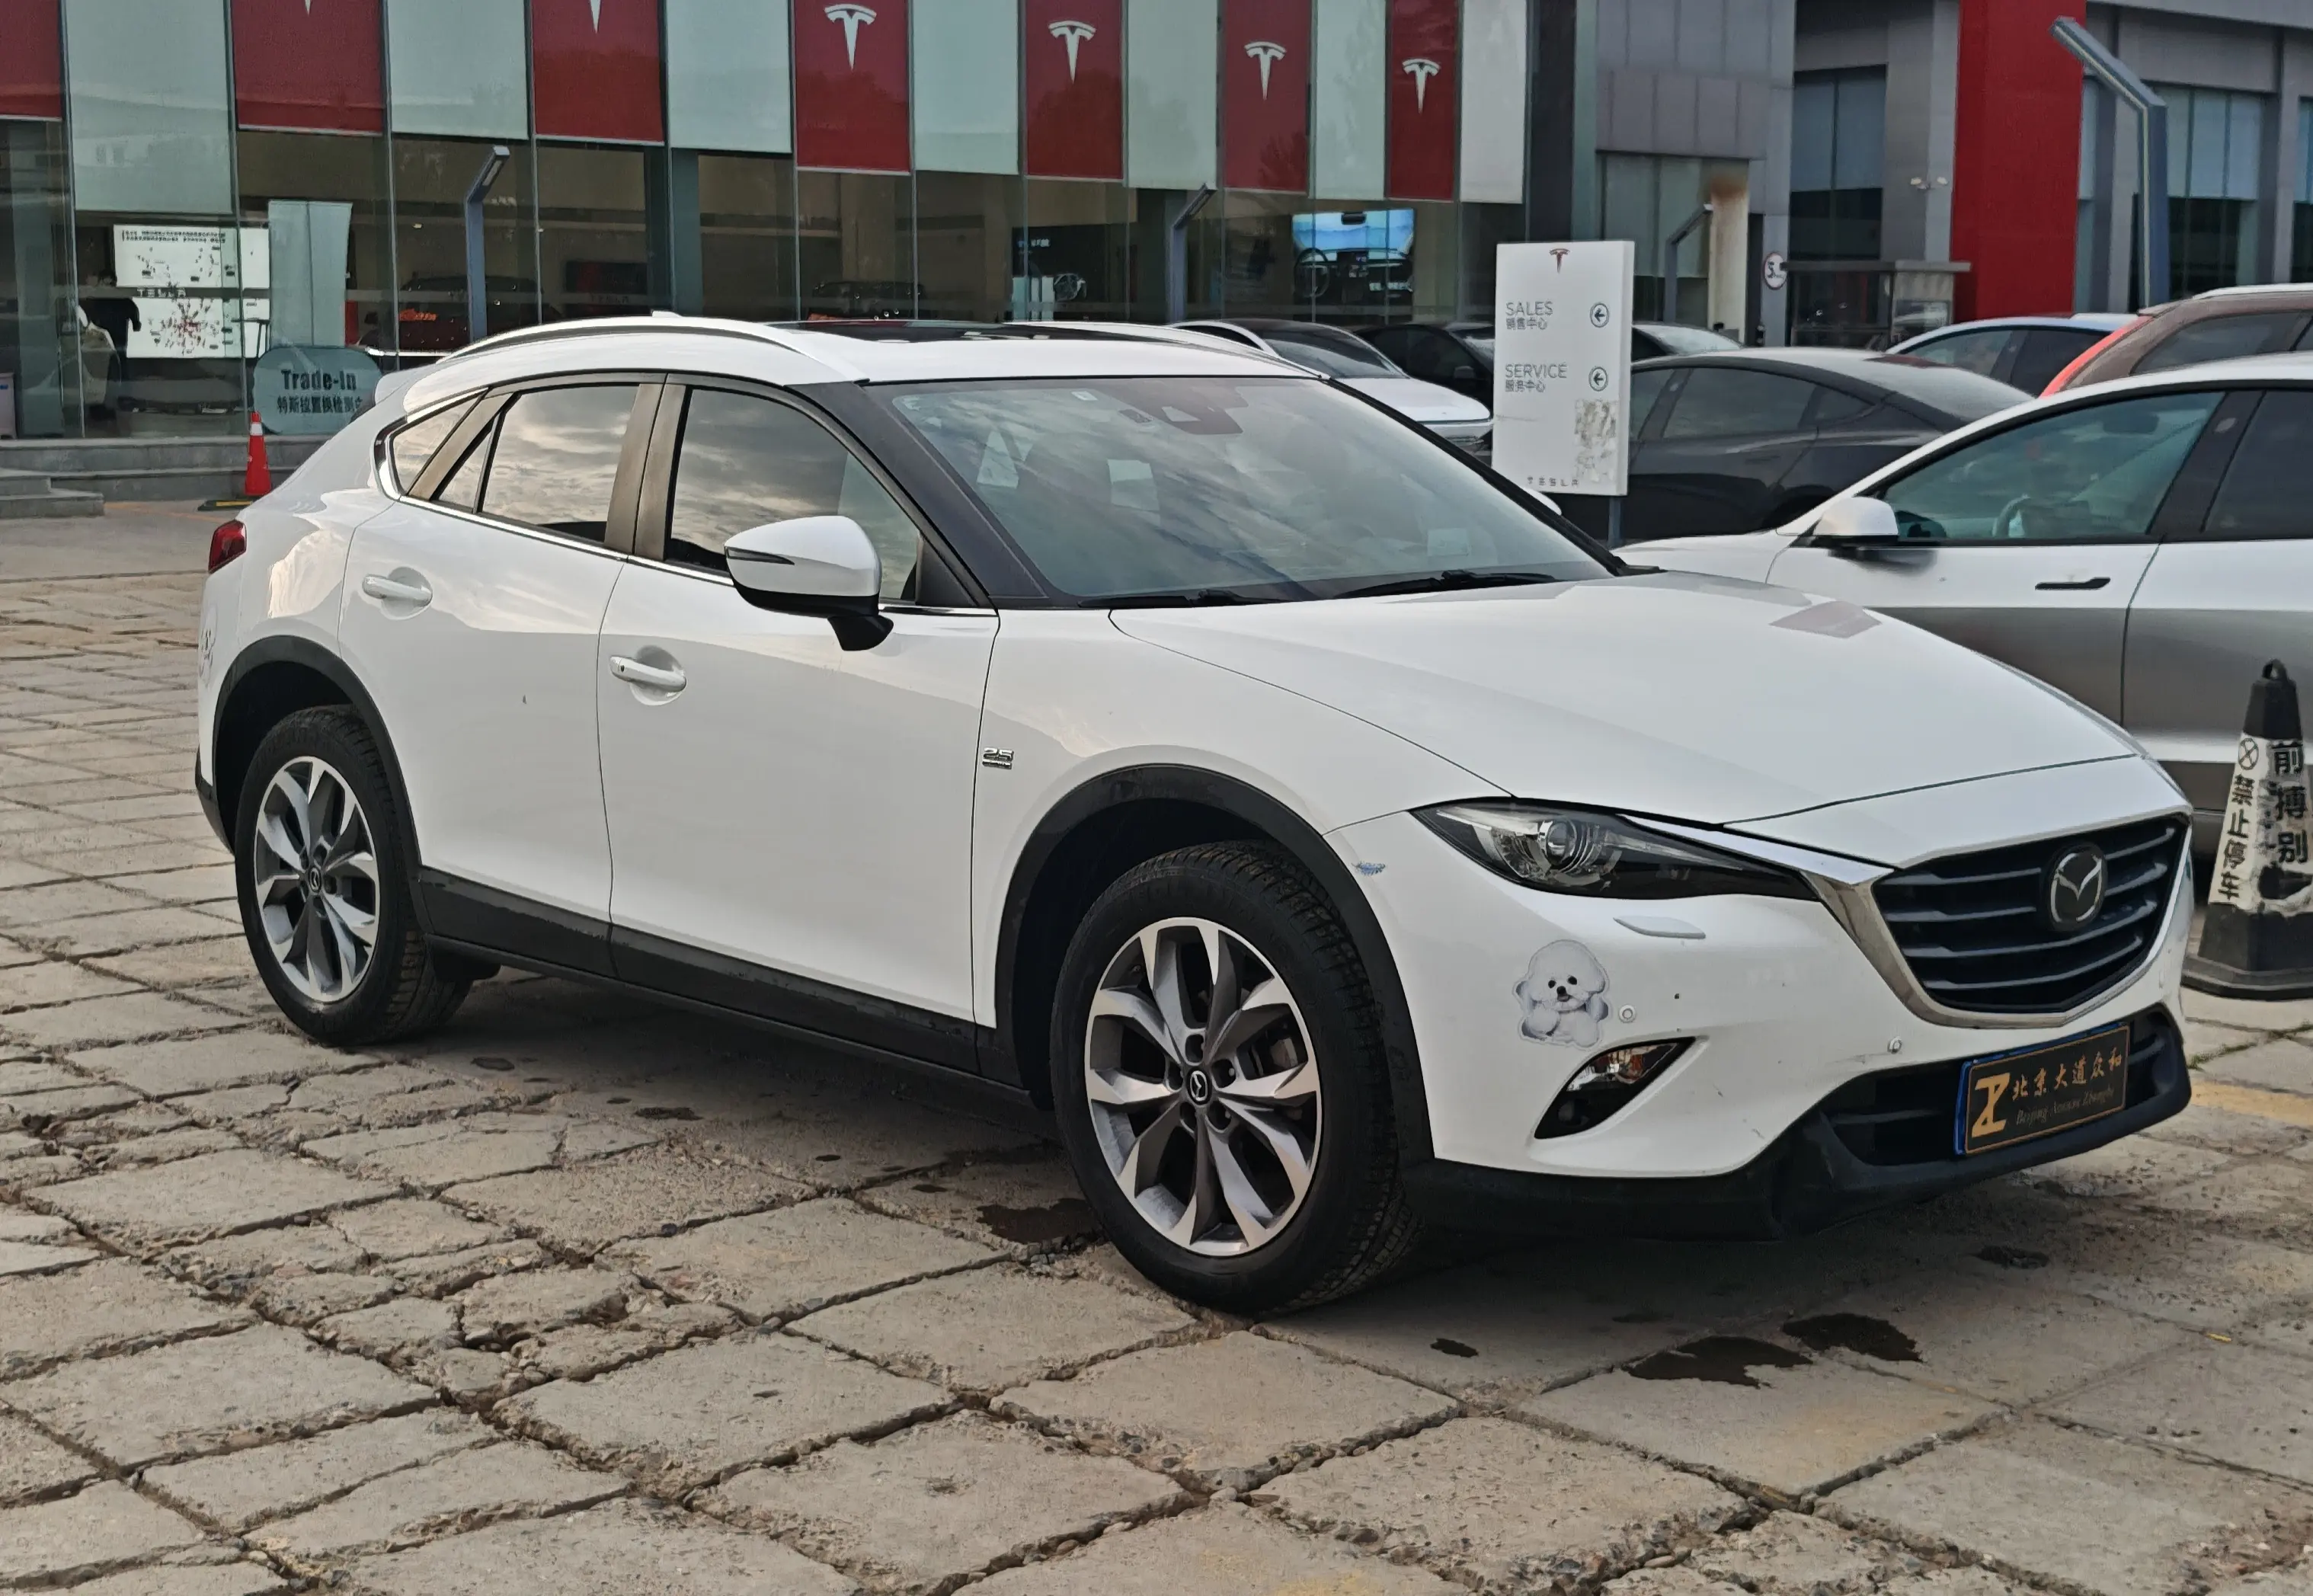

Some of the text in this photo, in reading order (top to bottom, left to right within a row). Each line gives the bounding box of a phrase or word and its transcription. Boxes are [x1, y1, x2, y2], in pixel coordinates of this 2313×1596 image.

[1505, 301, 1553, 318] SALES
[281, 368, 357, 391] Trade-In
[1505, 362, 1568, 379] SERVICE
[2218, 773, 2255, 900] 禁止停车
